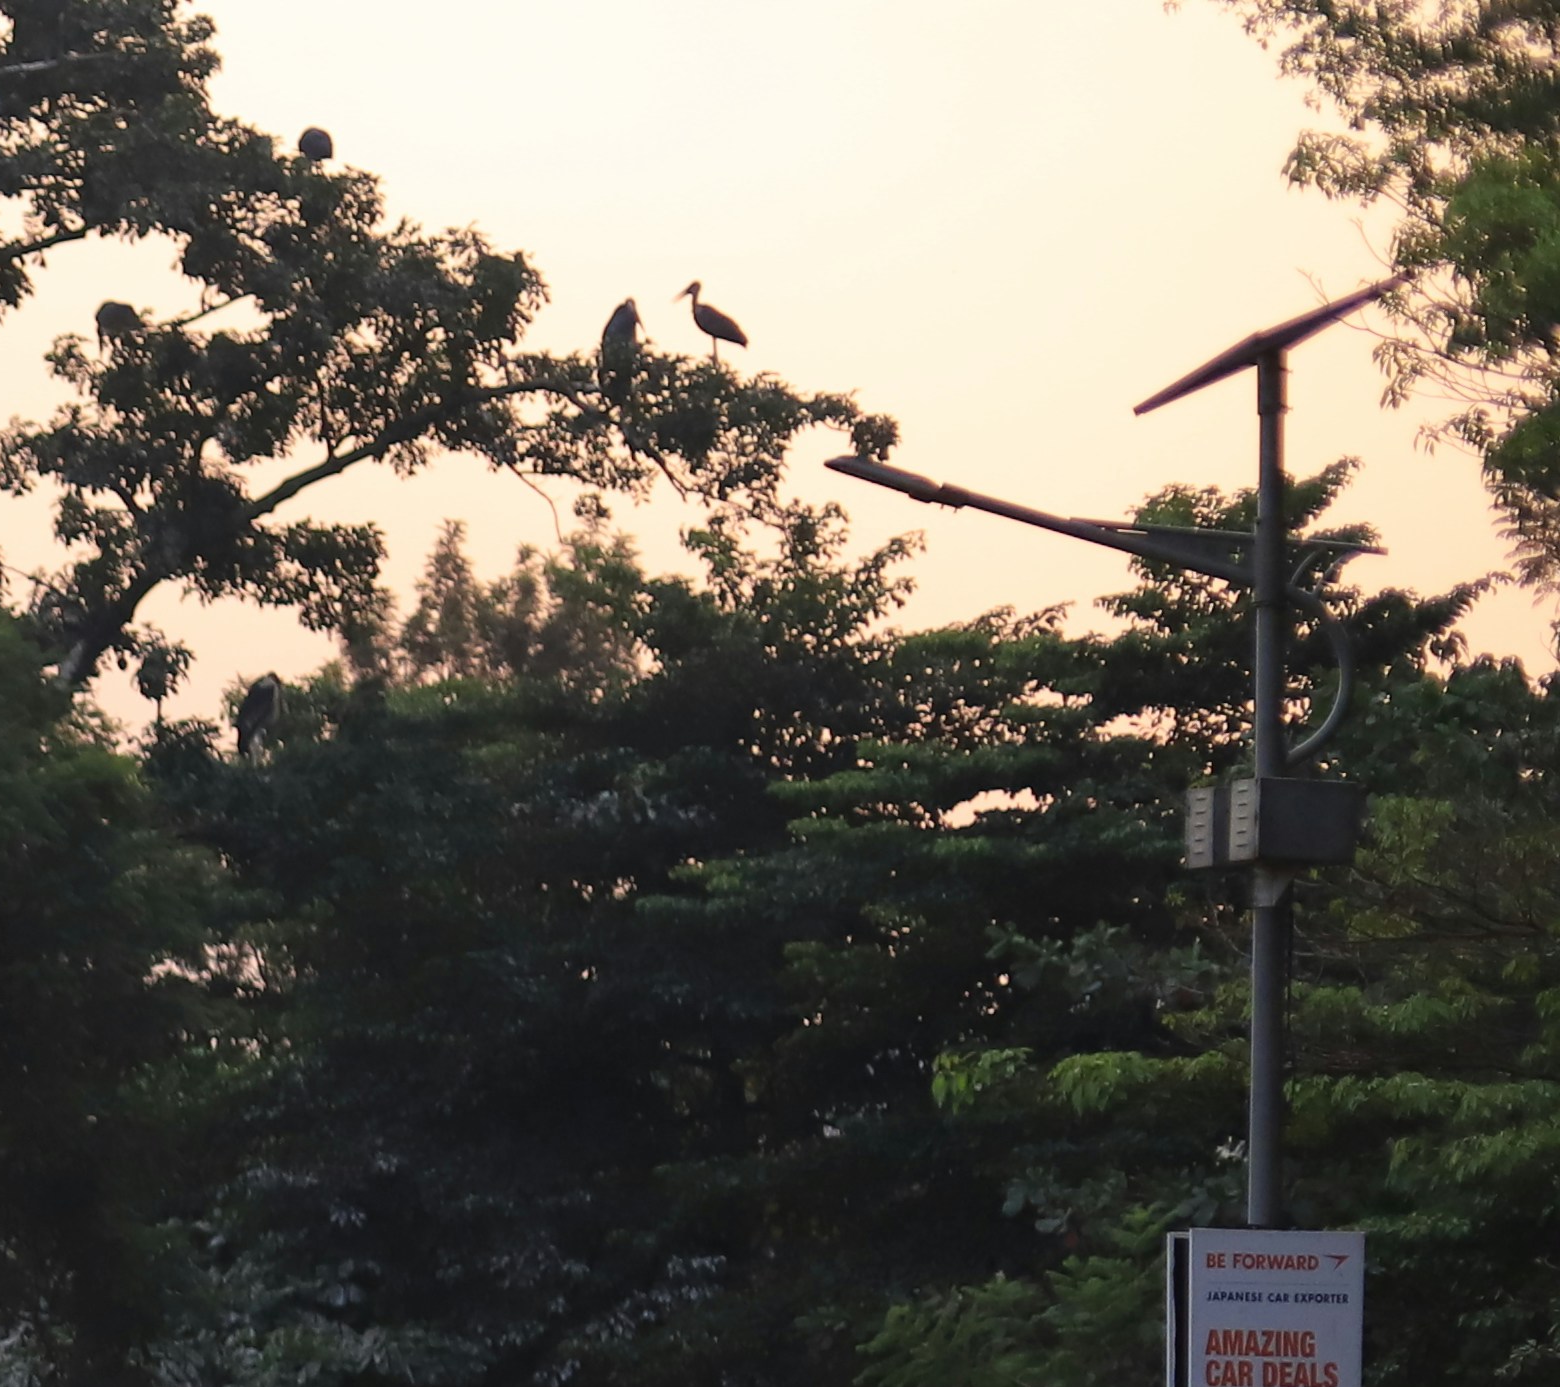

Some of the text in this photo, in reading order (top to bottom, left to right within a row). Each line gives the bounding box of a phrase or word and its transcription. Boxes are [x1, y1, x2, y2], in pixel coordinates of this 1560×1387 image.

[1206, 1253, 1320, 1271] BE FORWARD
[1207, 1291, 1349, 1305] JAPANESE CAR EXPORTER
[1205, 1329, 1316, 1358] AMAZING
[1205, 1360, 1253, 1387] CAR
